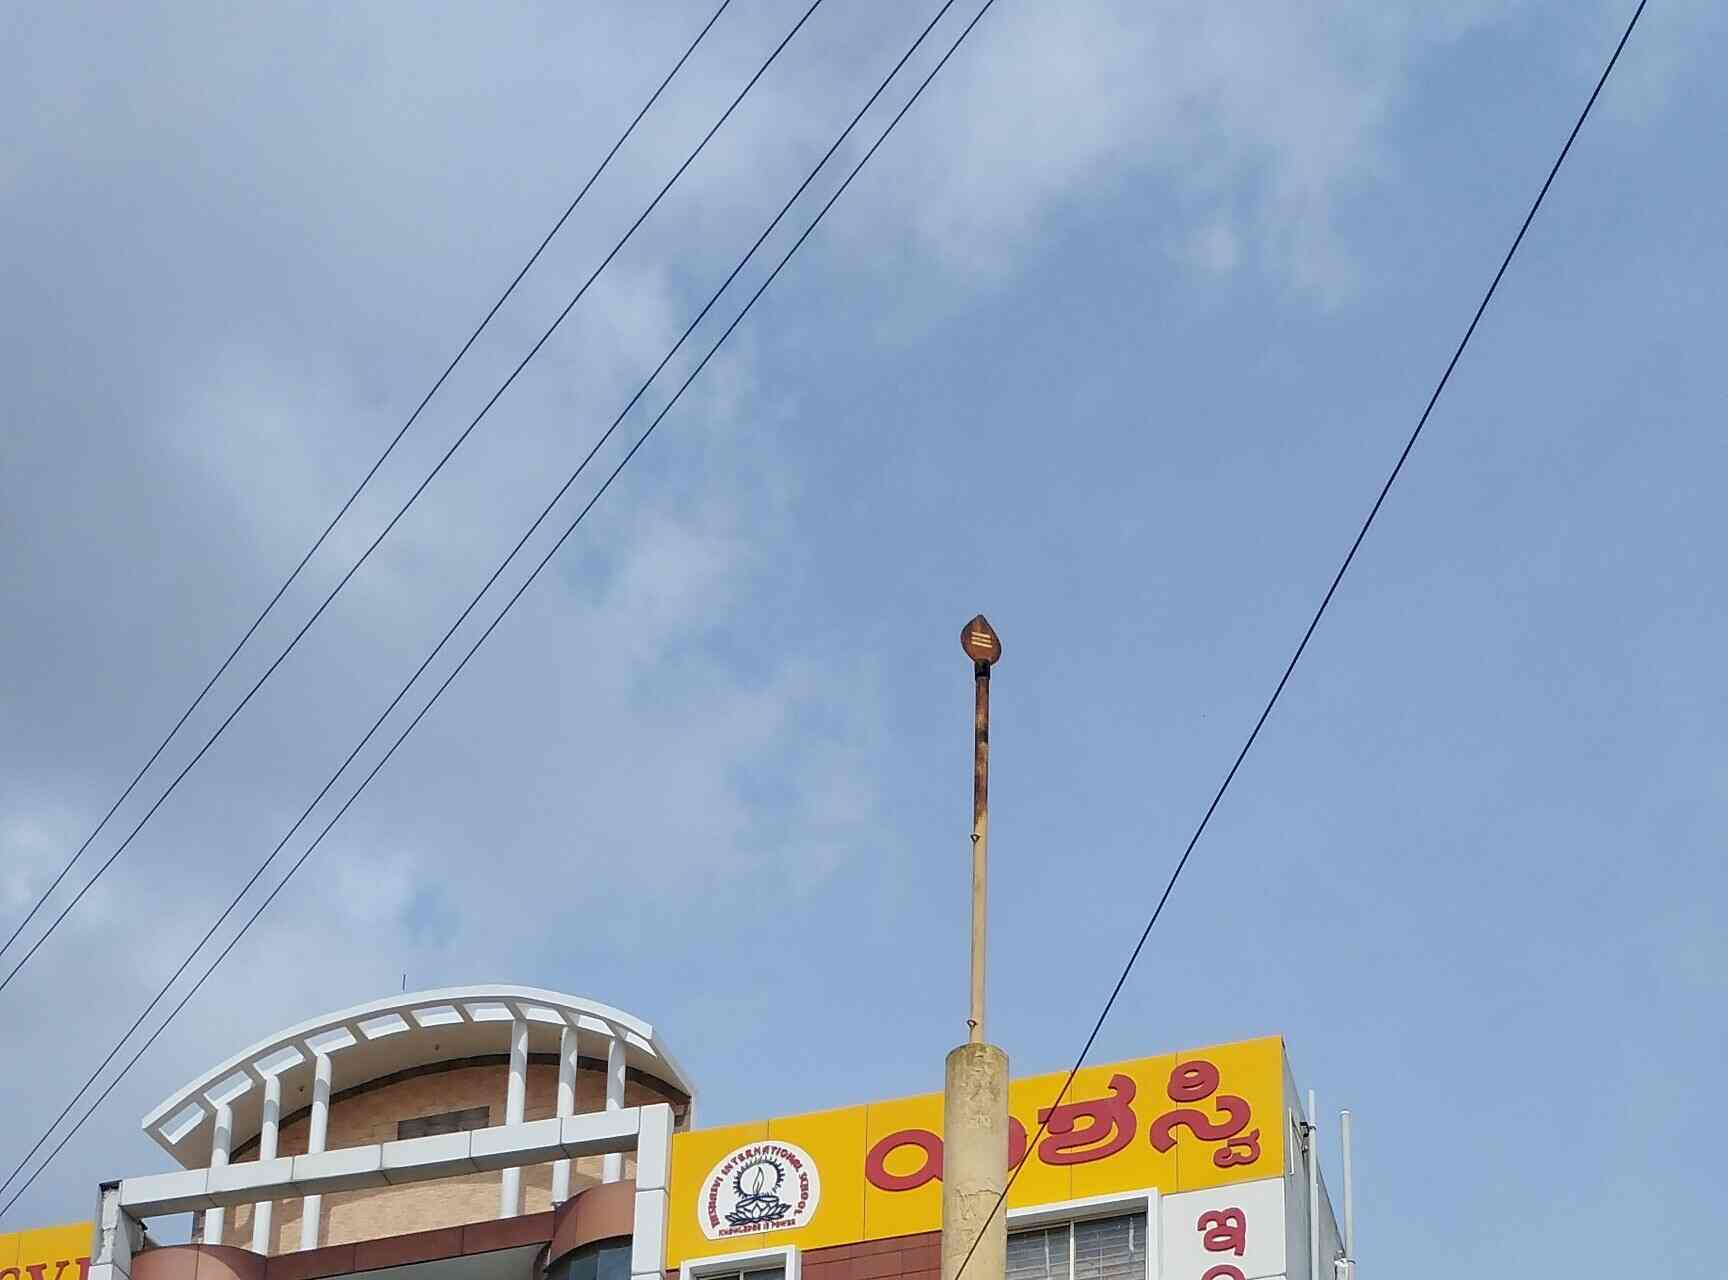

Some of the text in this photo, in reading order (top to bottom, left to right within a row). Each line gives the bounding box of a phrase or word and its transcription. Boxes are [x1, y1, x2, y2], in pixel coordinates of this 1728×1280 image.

[721, 1145, 803, 1176] INTERNATIONAL
[794, 1171, 809, 1216] SCHOOL
[718, 1218, 796, 1237] KNOWLEDGE IS POWER
